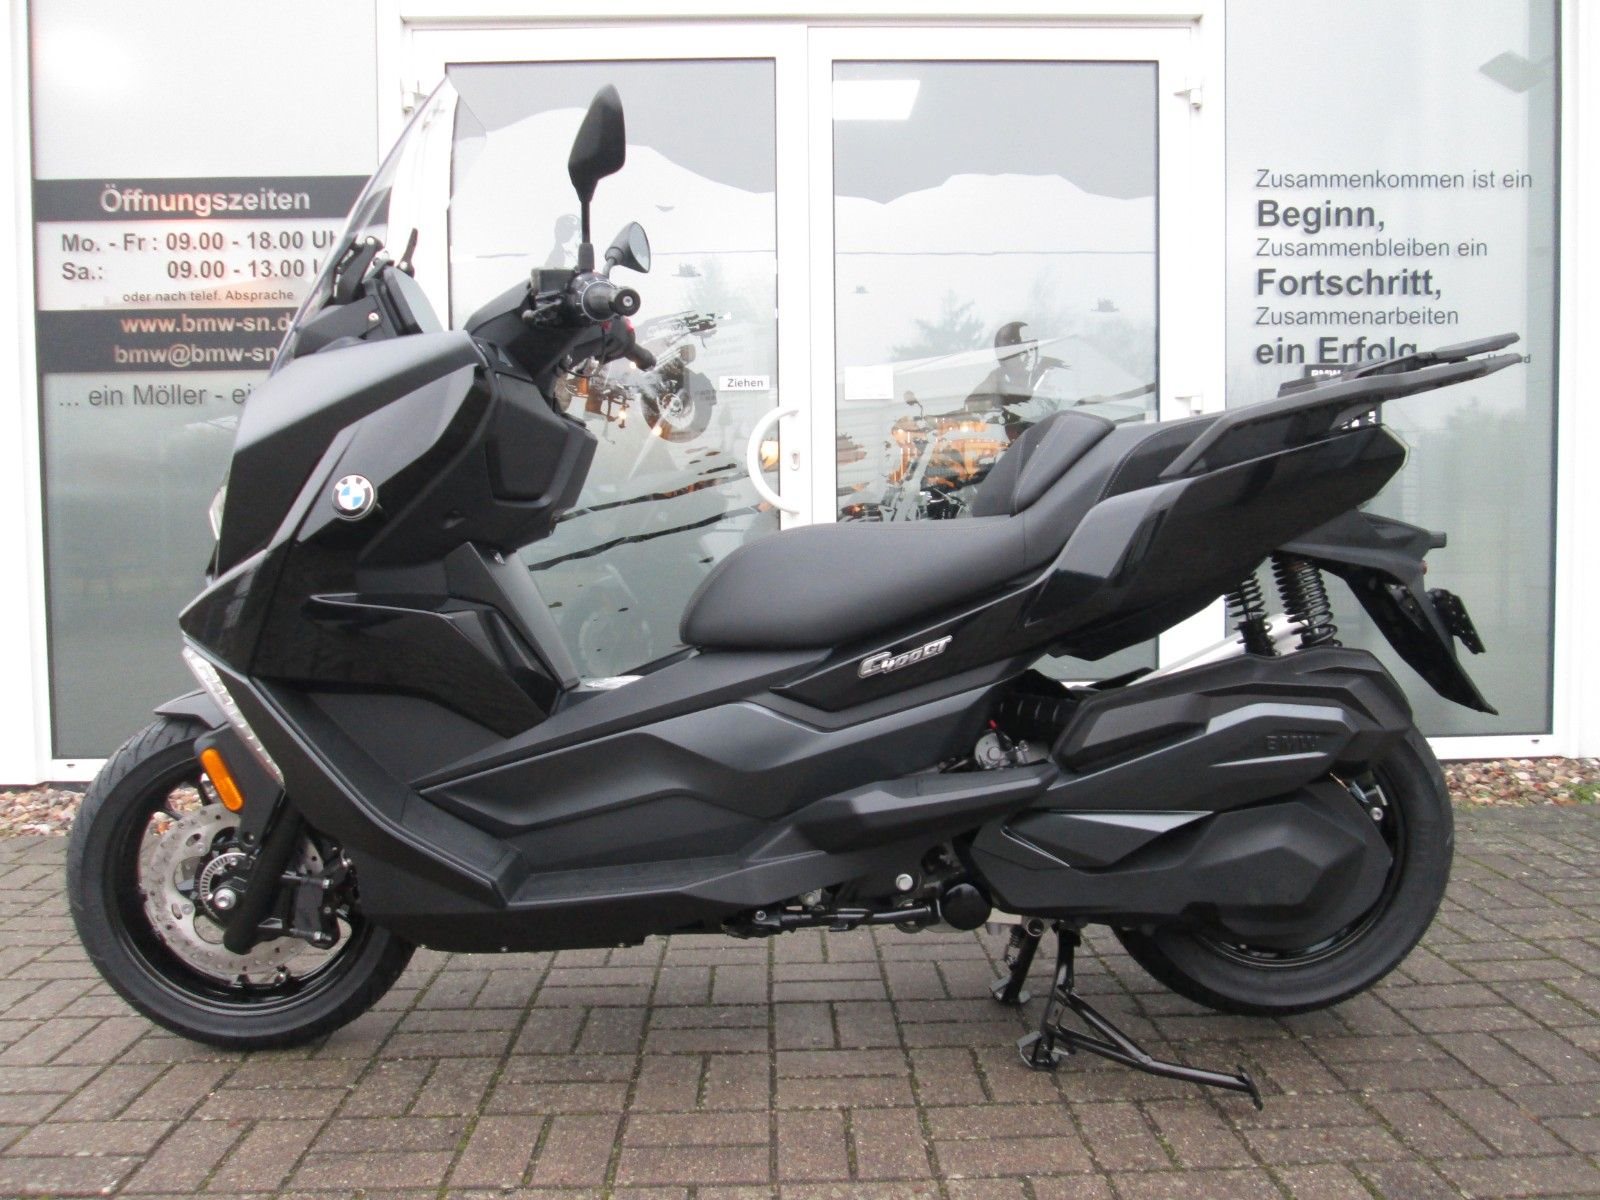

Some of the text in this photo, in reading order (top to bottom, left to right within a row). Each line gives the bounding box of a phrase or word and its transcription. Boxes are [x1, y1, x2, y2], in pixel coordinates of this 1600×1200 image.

[1256, 168, 1533, 189] Zusammenkommen ist ein
[101, 184, 311, 217] Öffnungszeiten
[1257, 199, 1385, 234] Beginn,
[62, 234, 100, 252] Mo.
[166, 232, 224, 250] 09.00
[247, 231, 303, 249] 18.00
[1256, 238, 1488, 257] Zusammenbleiben ein
[62, 263, 103, 281] Sa.:
[167, 260, 225, 279] 09.00
[248, 259, 304, 278] 13.00
[1257, 268, 1442, 300] Fortschritt,
[123, 290, 294, 304] oder nach telef. Absprache
[121, 312, 293, 333] www.bmw-sn.d
[1256, 307, 1459, 325] Zusammenarbeiten
[115, 344, 276, 367] bmw@bmw-sn
[1256, 338, 1305, 364] ein
[727, 378, 764, 388] Ziehen
[88, 386, 123, 405] ein
[133, 384, 206, 405] Möller
